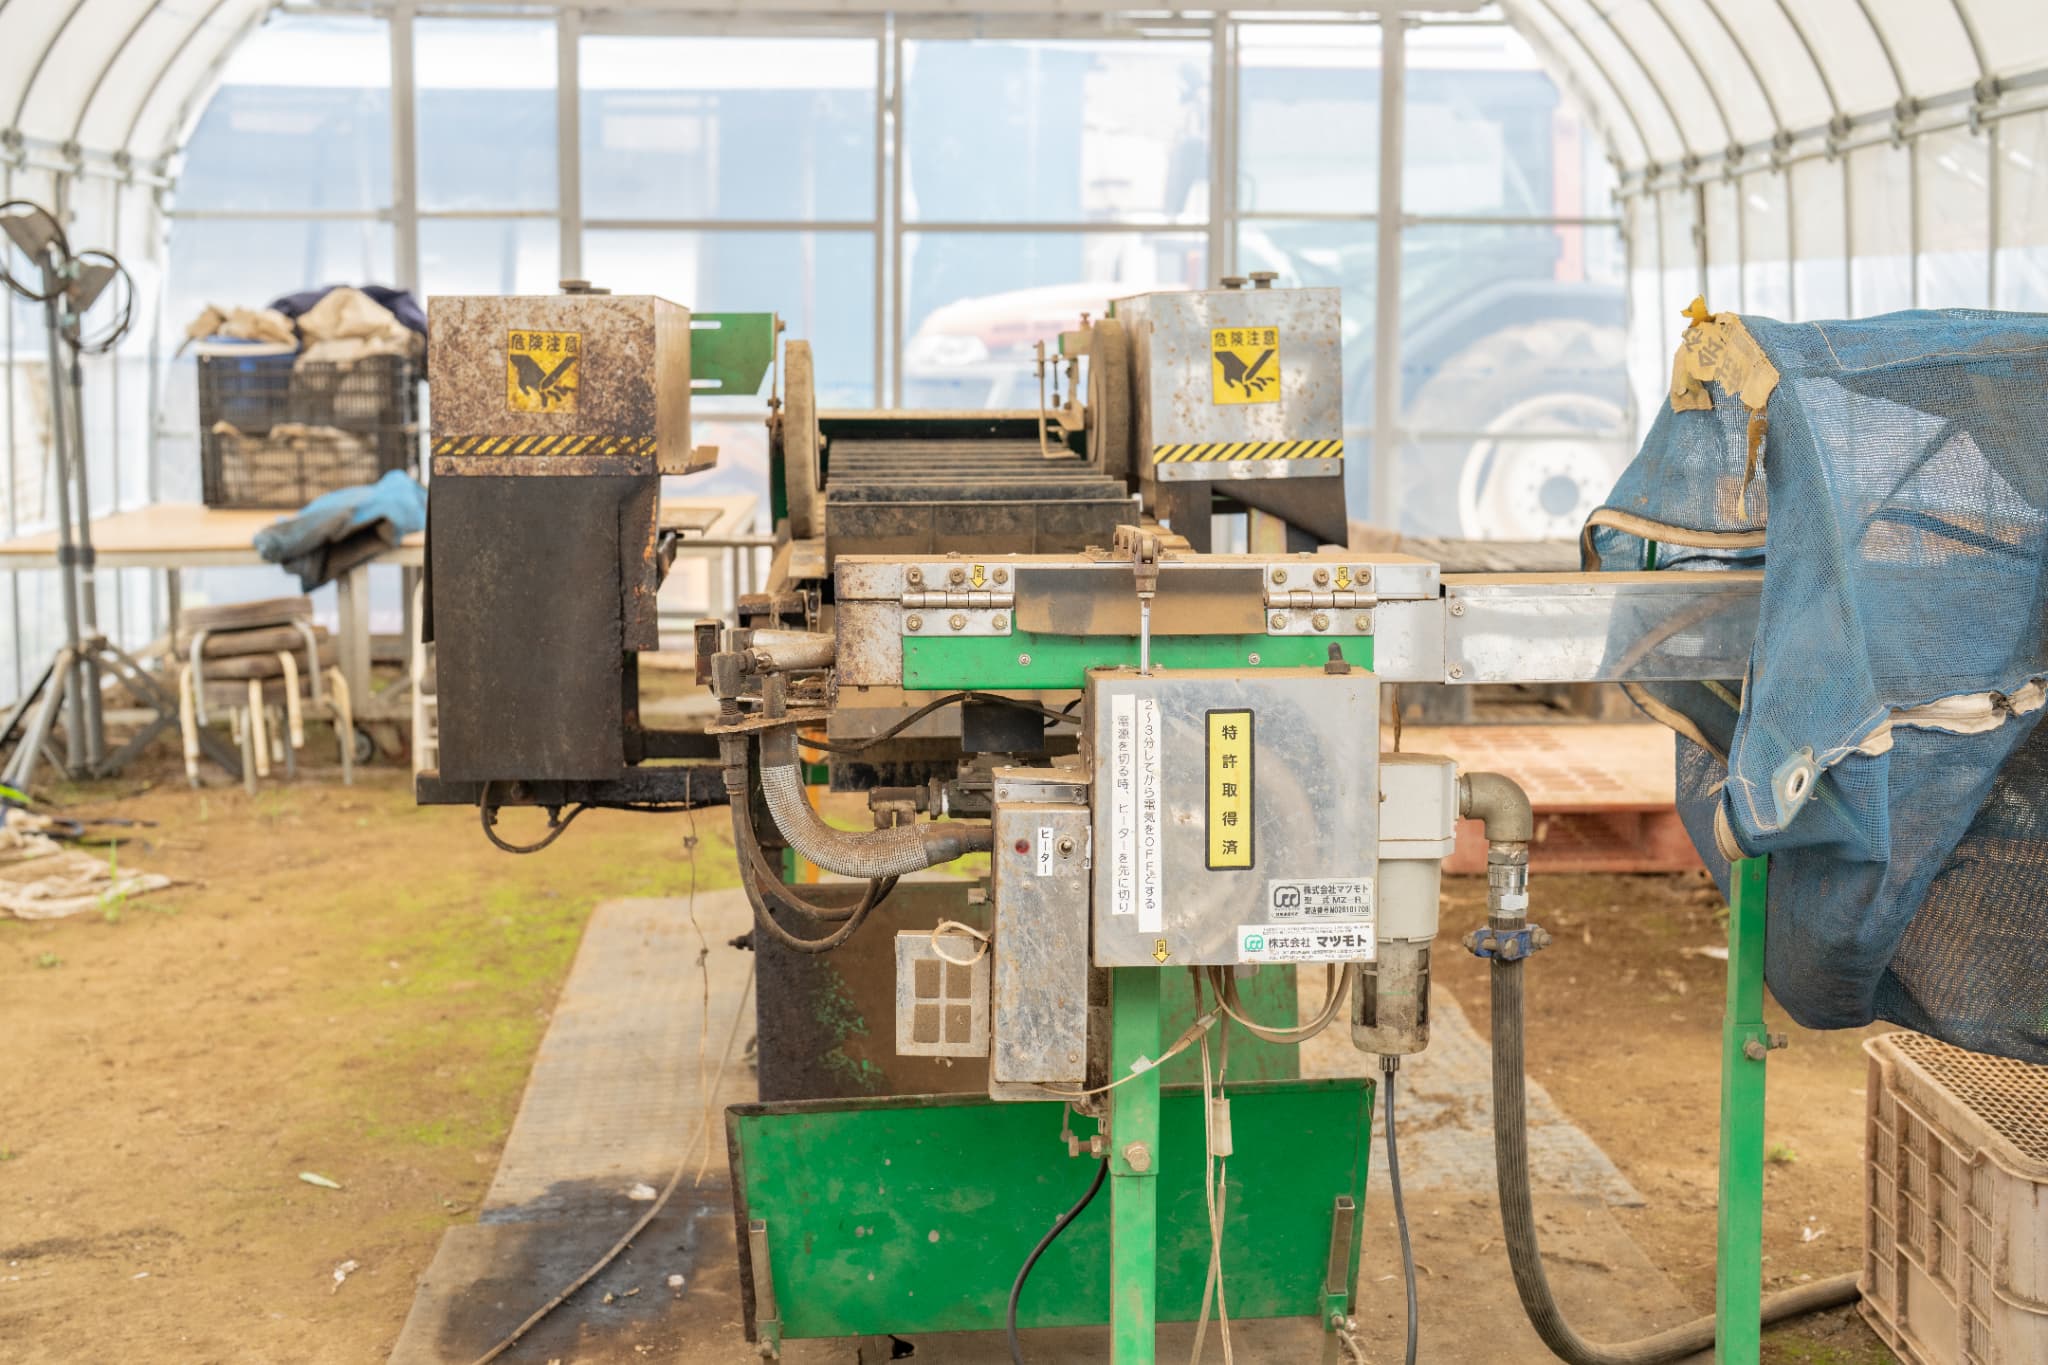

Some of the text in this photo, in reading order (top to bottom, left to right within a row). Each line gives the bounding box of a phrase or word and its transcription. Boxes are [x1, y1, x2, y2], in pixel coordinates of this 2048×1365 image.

[511, 333, 577, 352] 危険注意
[1214, 330, 1275, 347] 危険注意
[1222, 725, 1238, 855] 特許取得済
[1041, 829, 1049, 874] ヒーター
[1303, 885, 1368, 895] 株式会社マツモト
[1268, 935, 1367, 949] 株式会社 マツモト
